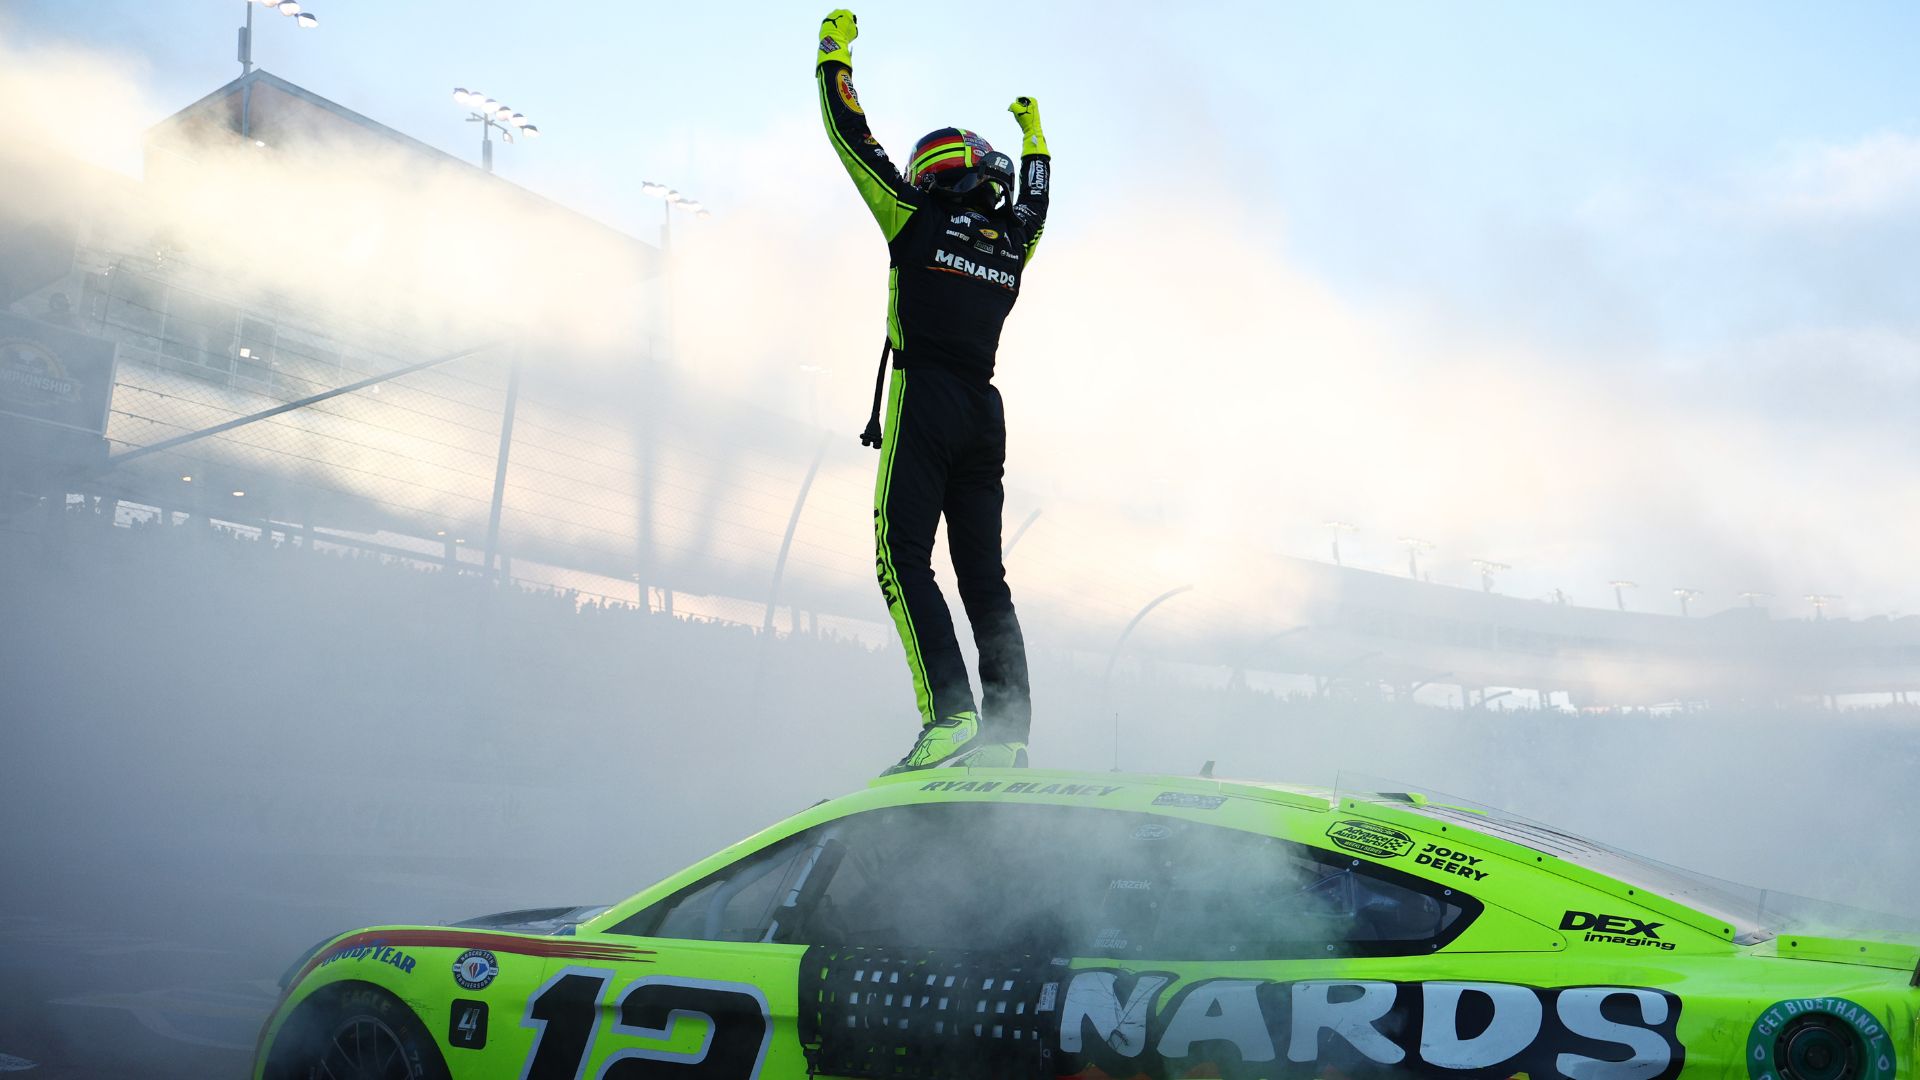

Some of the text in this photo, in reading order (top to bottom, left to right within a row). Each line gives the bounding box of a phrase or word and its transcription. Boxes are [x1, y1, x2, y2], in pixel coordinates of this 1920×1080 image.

[994, 156, 1009, 169] 12
[934, 249, 1015, 287] MENARDS
[920, 781, 1123, 797] RYAN BLANEY
[1333, 830, 1384, 847] Auto Parts
[1344, 827, 1389, 842] Advance
[1421, 843, 1483, 866] JODY
[1414, 854, 1489, 881] DEERY
[1109, 879, 1152, 890] Mazak
[1559, 910, 1664, 939] DEX
[1584, 932, 1676, 951] imaging
[458, 1007, 481, 1041] 4
[519, 965, 774, 1080] 12
[1059, 971, 1672, 1080] NARDS
[1758, 998, 1886, 1049] GET BIOETHANOL
